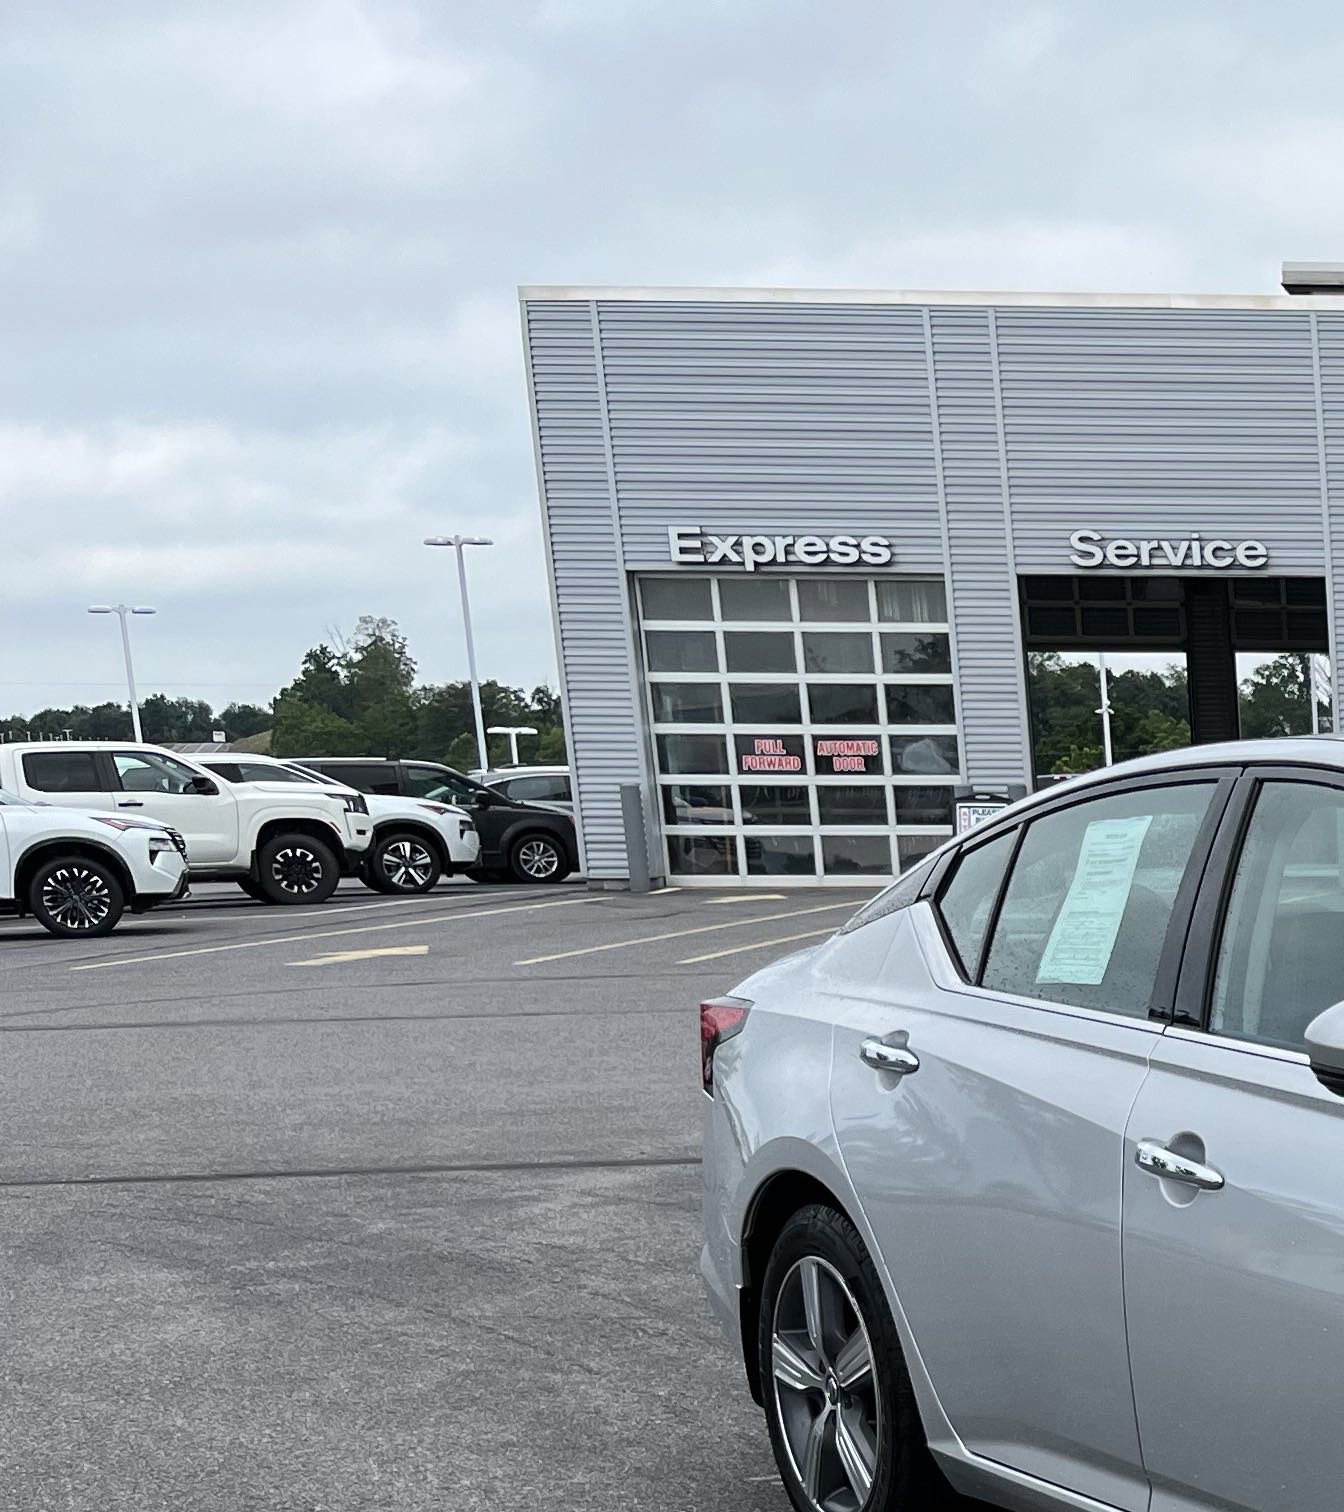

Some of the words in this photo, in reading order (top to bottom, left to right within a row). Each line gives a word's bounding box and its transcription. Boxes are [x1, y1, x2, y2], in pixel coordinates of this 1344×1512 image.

[668, 525, 892, 572] Express
[1069, 529, 1268, 568] Service
[754, 739, 786, 755] PULL
[817, 740, 879, 756] AUTOMATIC
[742, 755, 801, 771] FORWARD
[833, 757, 866, 772] DOOR
